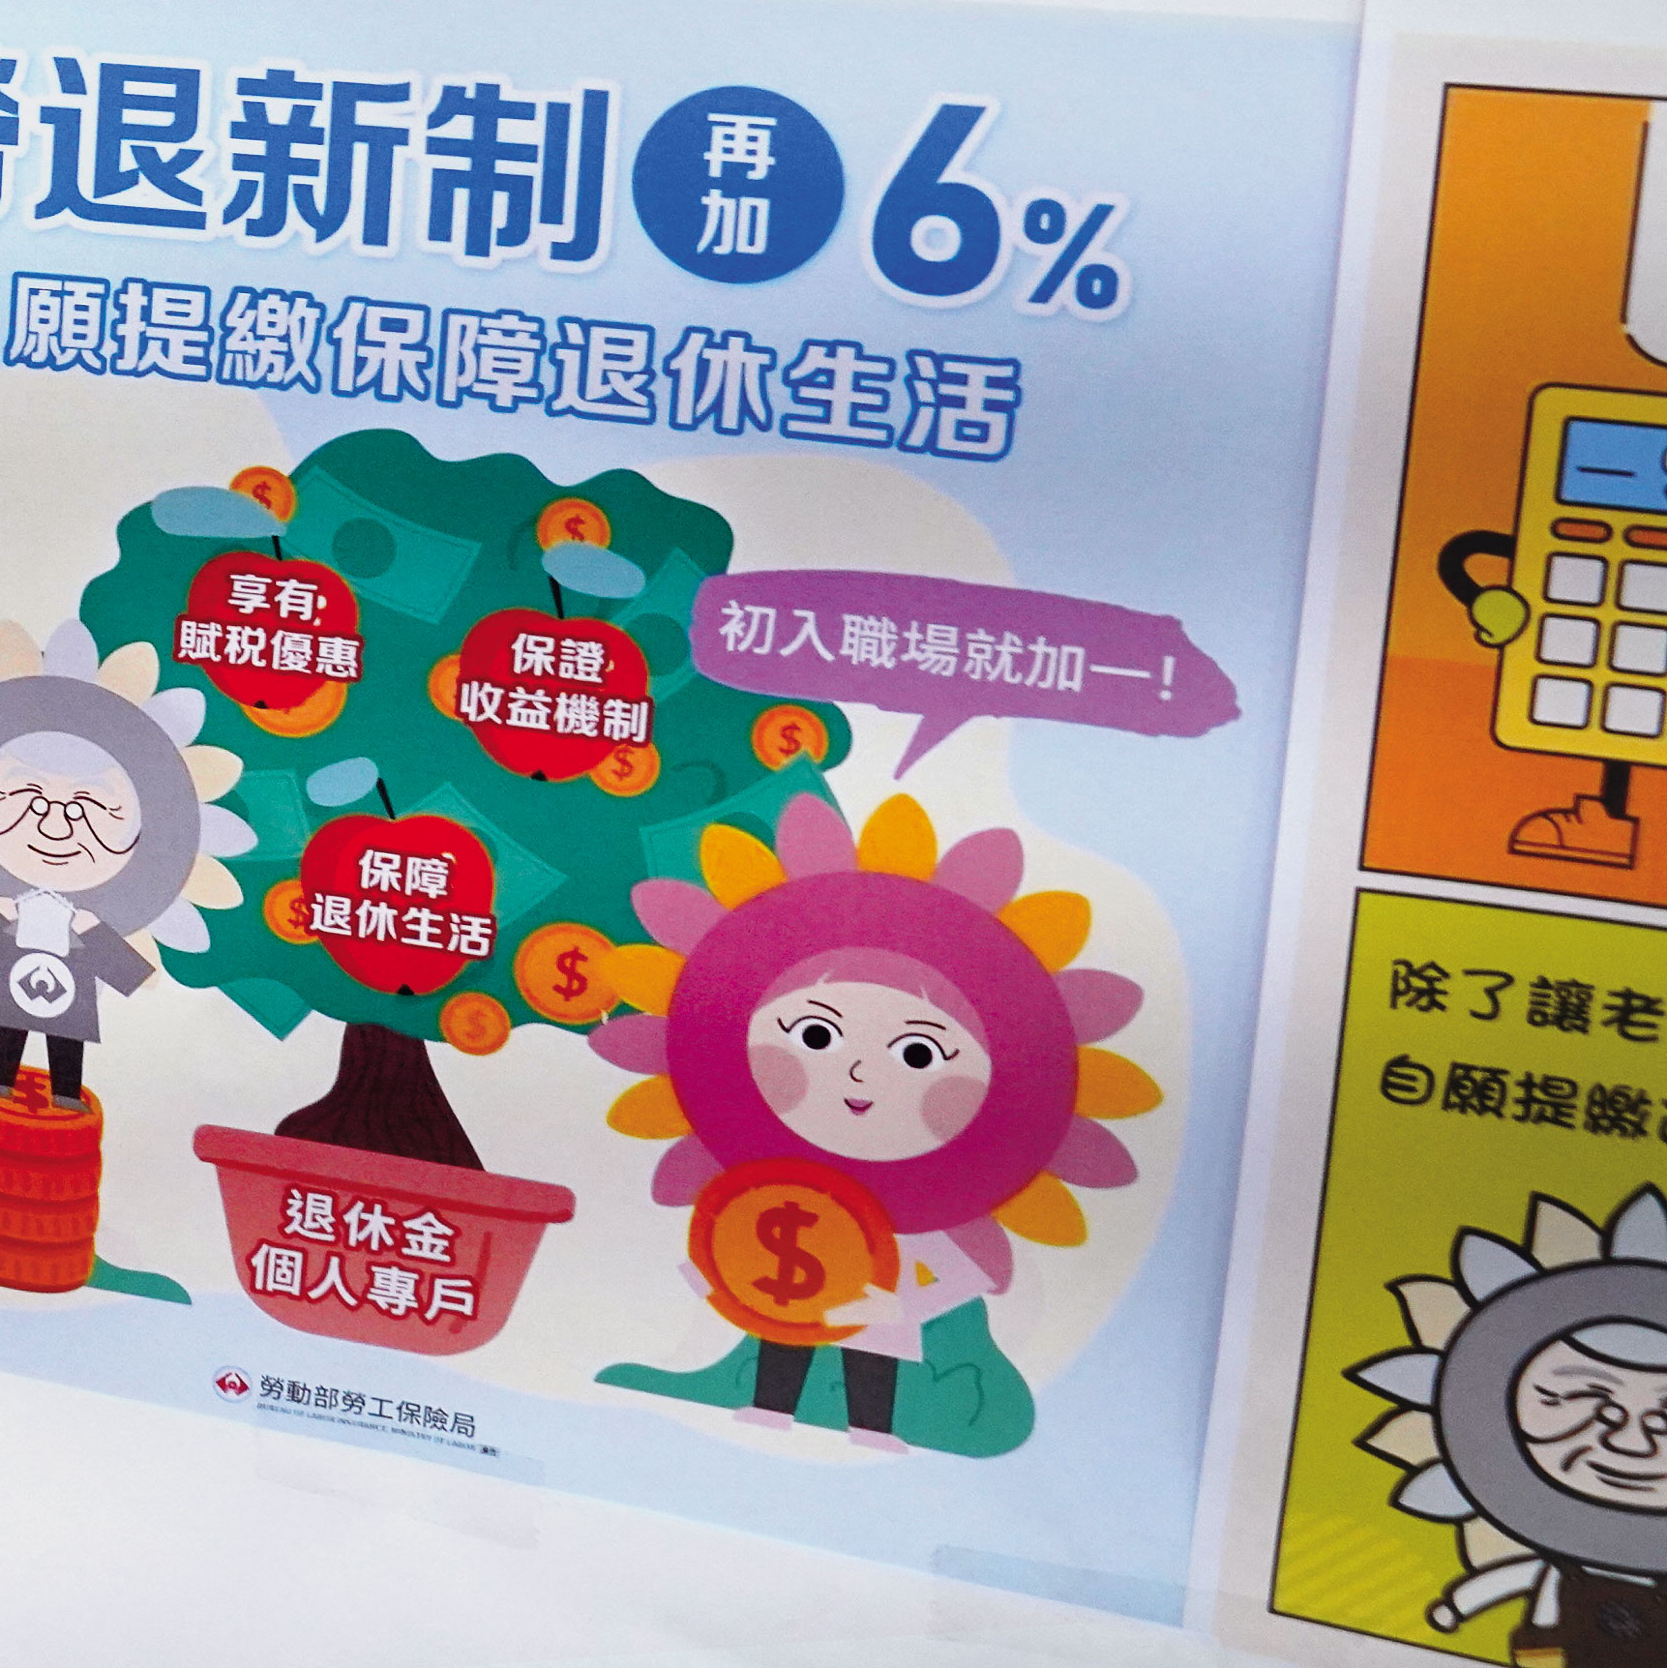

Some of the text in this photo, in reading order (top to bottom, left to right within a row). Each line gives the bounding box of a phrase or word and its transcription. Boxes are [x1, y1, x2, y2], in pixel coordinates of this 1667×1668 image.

[696, 112, 777, 255] 再加
[872, 102, 1120, 310] 6%
[227, 573, 319, 621] 享有
[511, 632, 605, 684] 保證
[459, 680, 649, 743] 收益機制
[358, 849, 450, 900] 保障
[309, 892, 493, 958] 退休生活
[1389, 958, 1666, 1043] 除了讓老
[1379, 1053, 1667, 1145] 自願提繳
[283, 1187, 456, 1263] 退休金
[250, 1242, 475, 1321] 個人專戶
[259, 1374, 477, 1439] 勞動部勞工保險局
